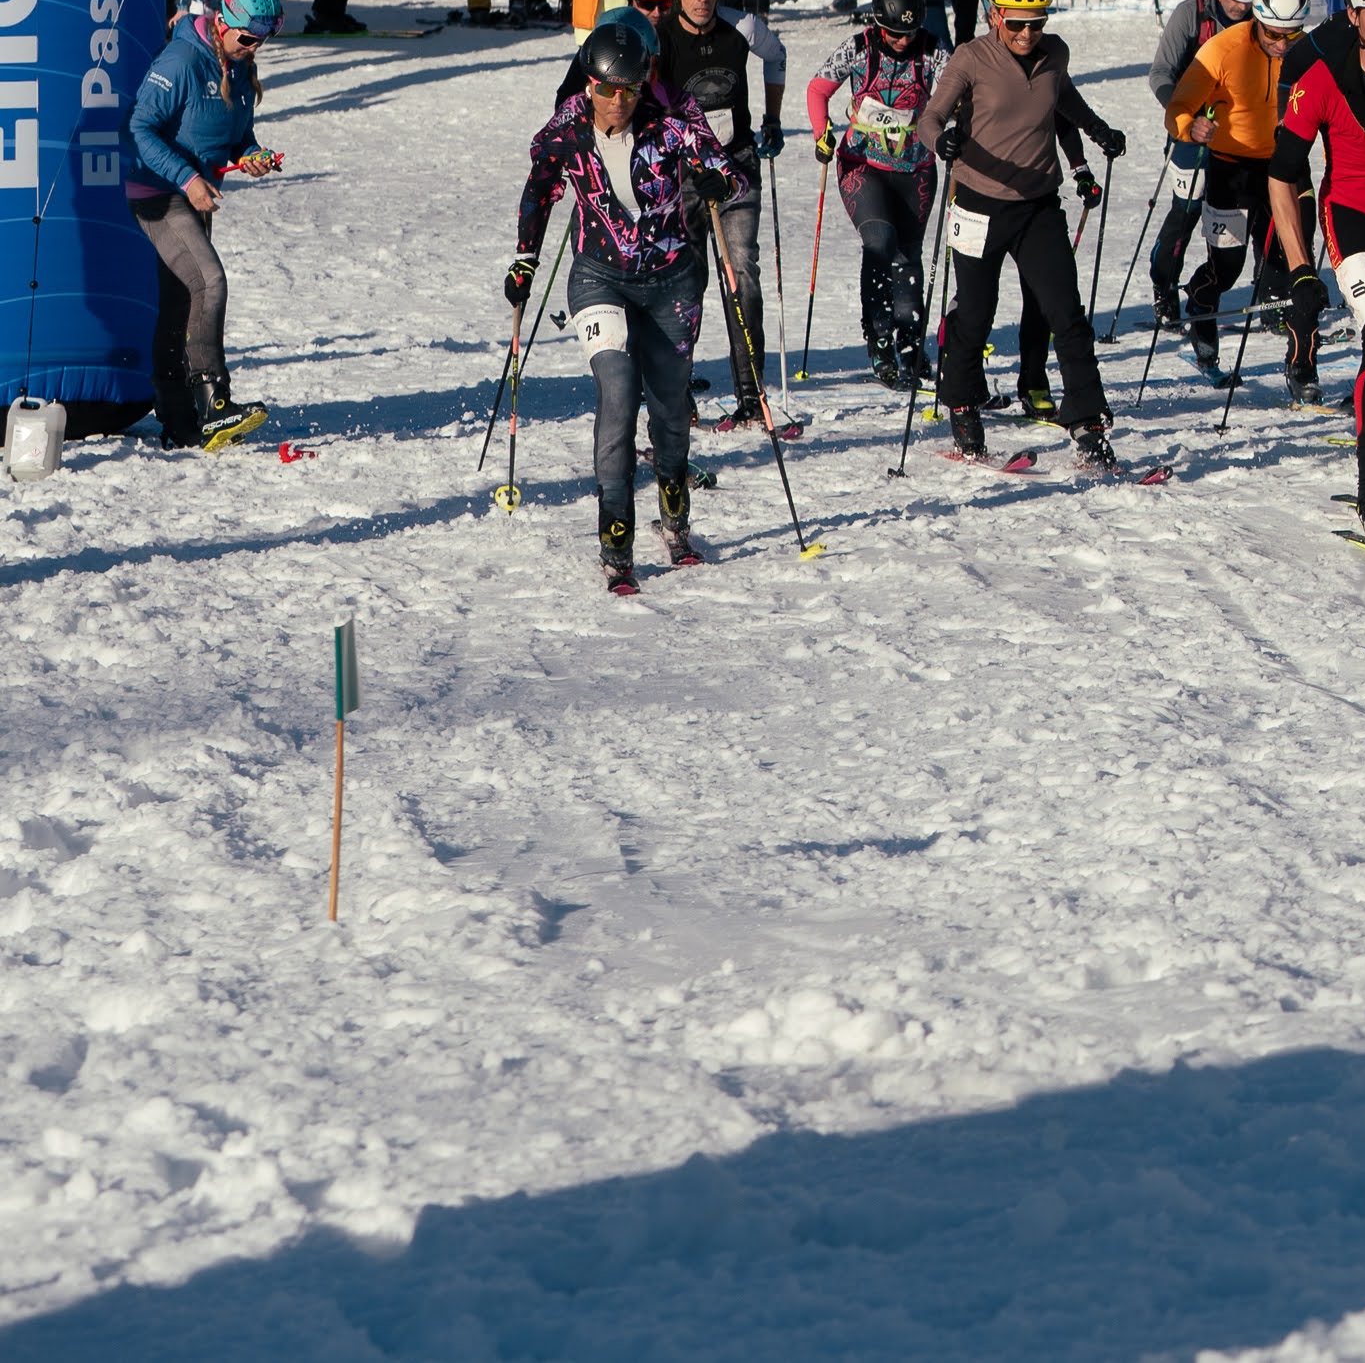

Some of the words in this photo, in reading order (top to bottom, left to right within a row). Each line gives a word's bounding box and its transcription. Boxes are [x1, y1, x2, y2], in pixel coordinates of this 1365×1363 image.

[876, 113, 893, 126] 36
[82, 132, 121, 187] El
[1176, 178, 1187, 190] 21
[953, 223, 961, 237] 9
[1212, 221, 1227, 236] 22
[585, 322, 601, 341] 24
[202, 414, 243, 433] FISCHER
